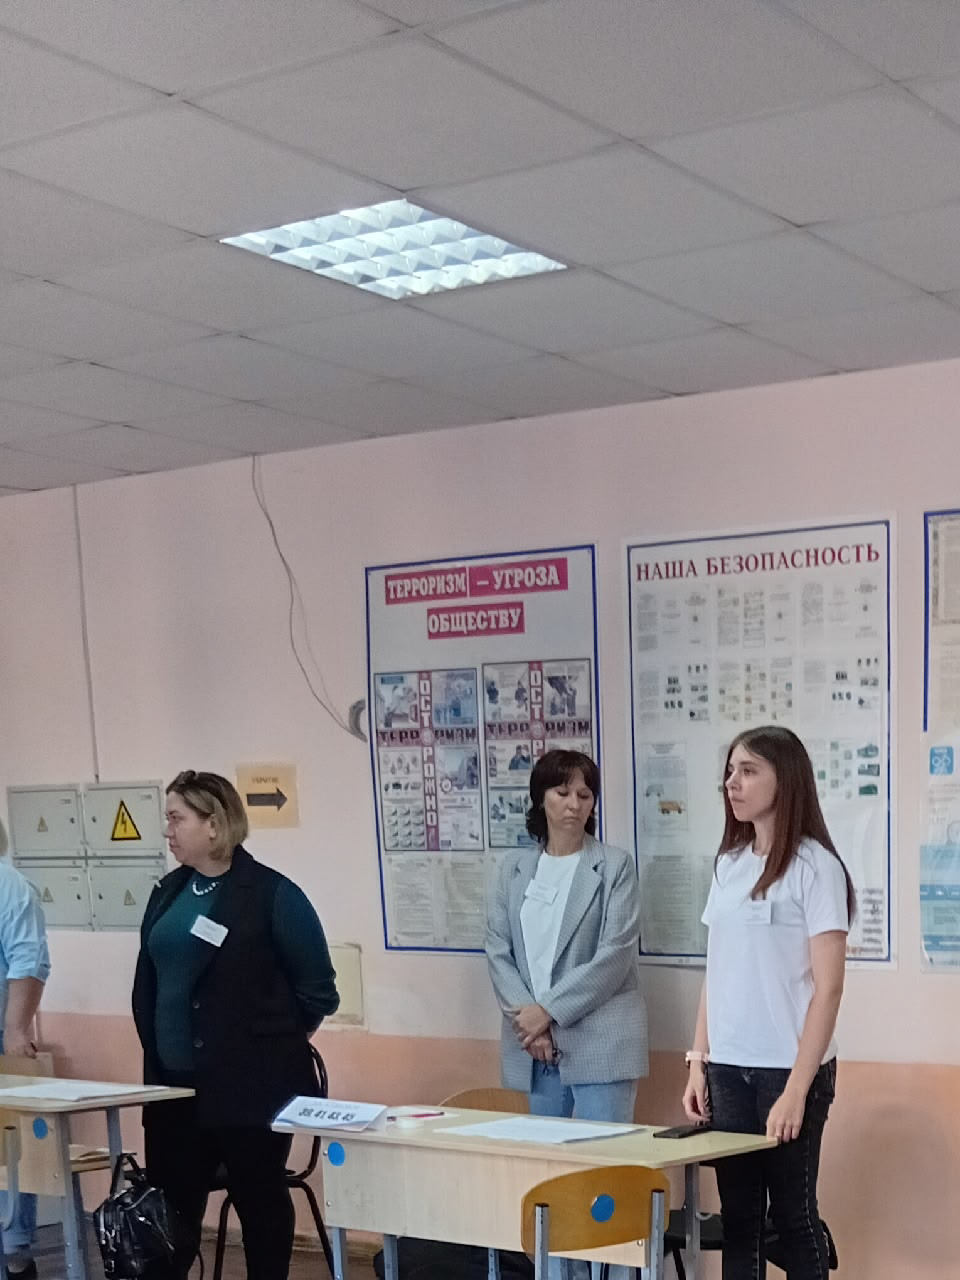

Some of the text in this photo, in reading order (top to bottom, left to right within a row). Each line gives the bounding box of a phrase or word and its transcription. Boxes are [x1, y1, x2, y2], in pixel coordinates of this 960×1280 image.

[636, 543, 880, 582] НАША БЕЗОПАСНОСТЬ
[387, 572, 467, 600] ТЕРРОРИЗМ
[492, 564, 560, 591] УГРОЗА
[428, 608, 521, 635] ОБЩЕСТВУ
